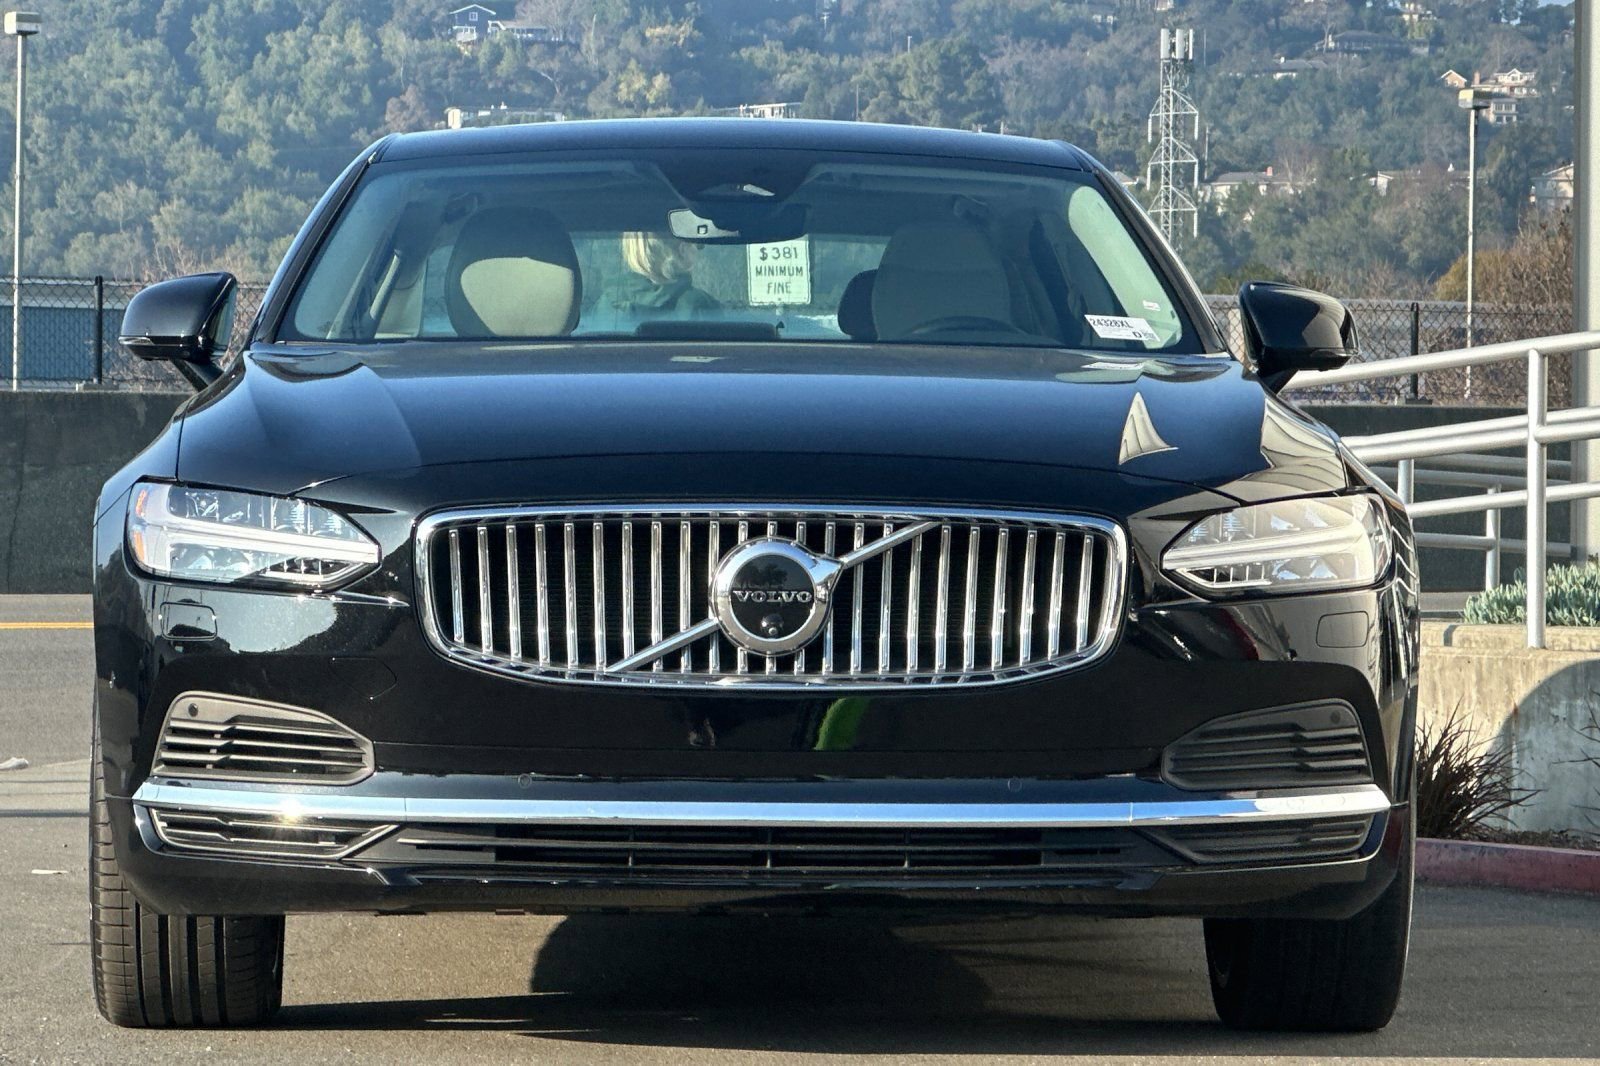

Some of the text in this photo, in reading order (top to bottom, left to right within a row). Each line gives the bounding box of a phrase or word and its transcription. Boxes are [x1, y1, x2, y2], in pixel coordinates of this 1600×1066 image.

[760, 247, 798, 261] $381
[755, 265, 803, 277] MINIMUM
[767, 282, 792, 294] FINE
[733, 590, 812, 602] VOLVO
